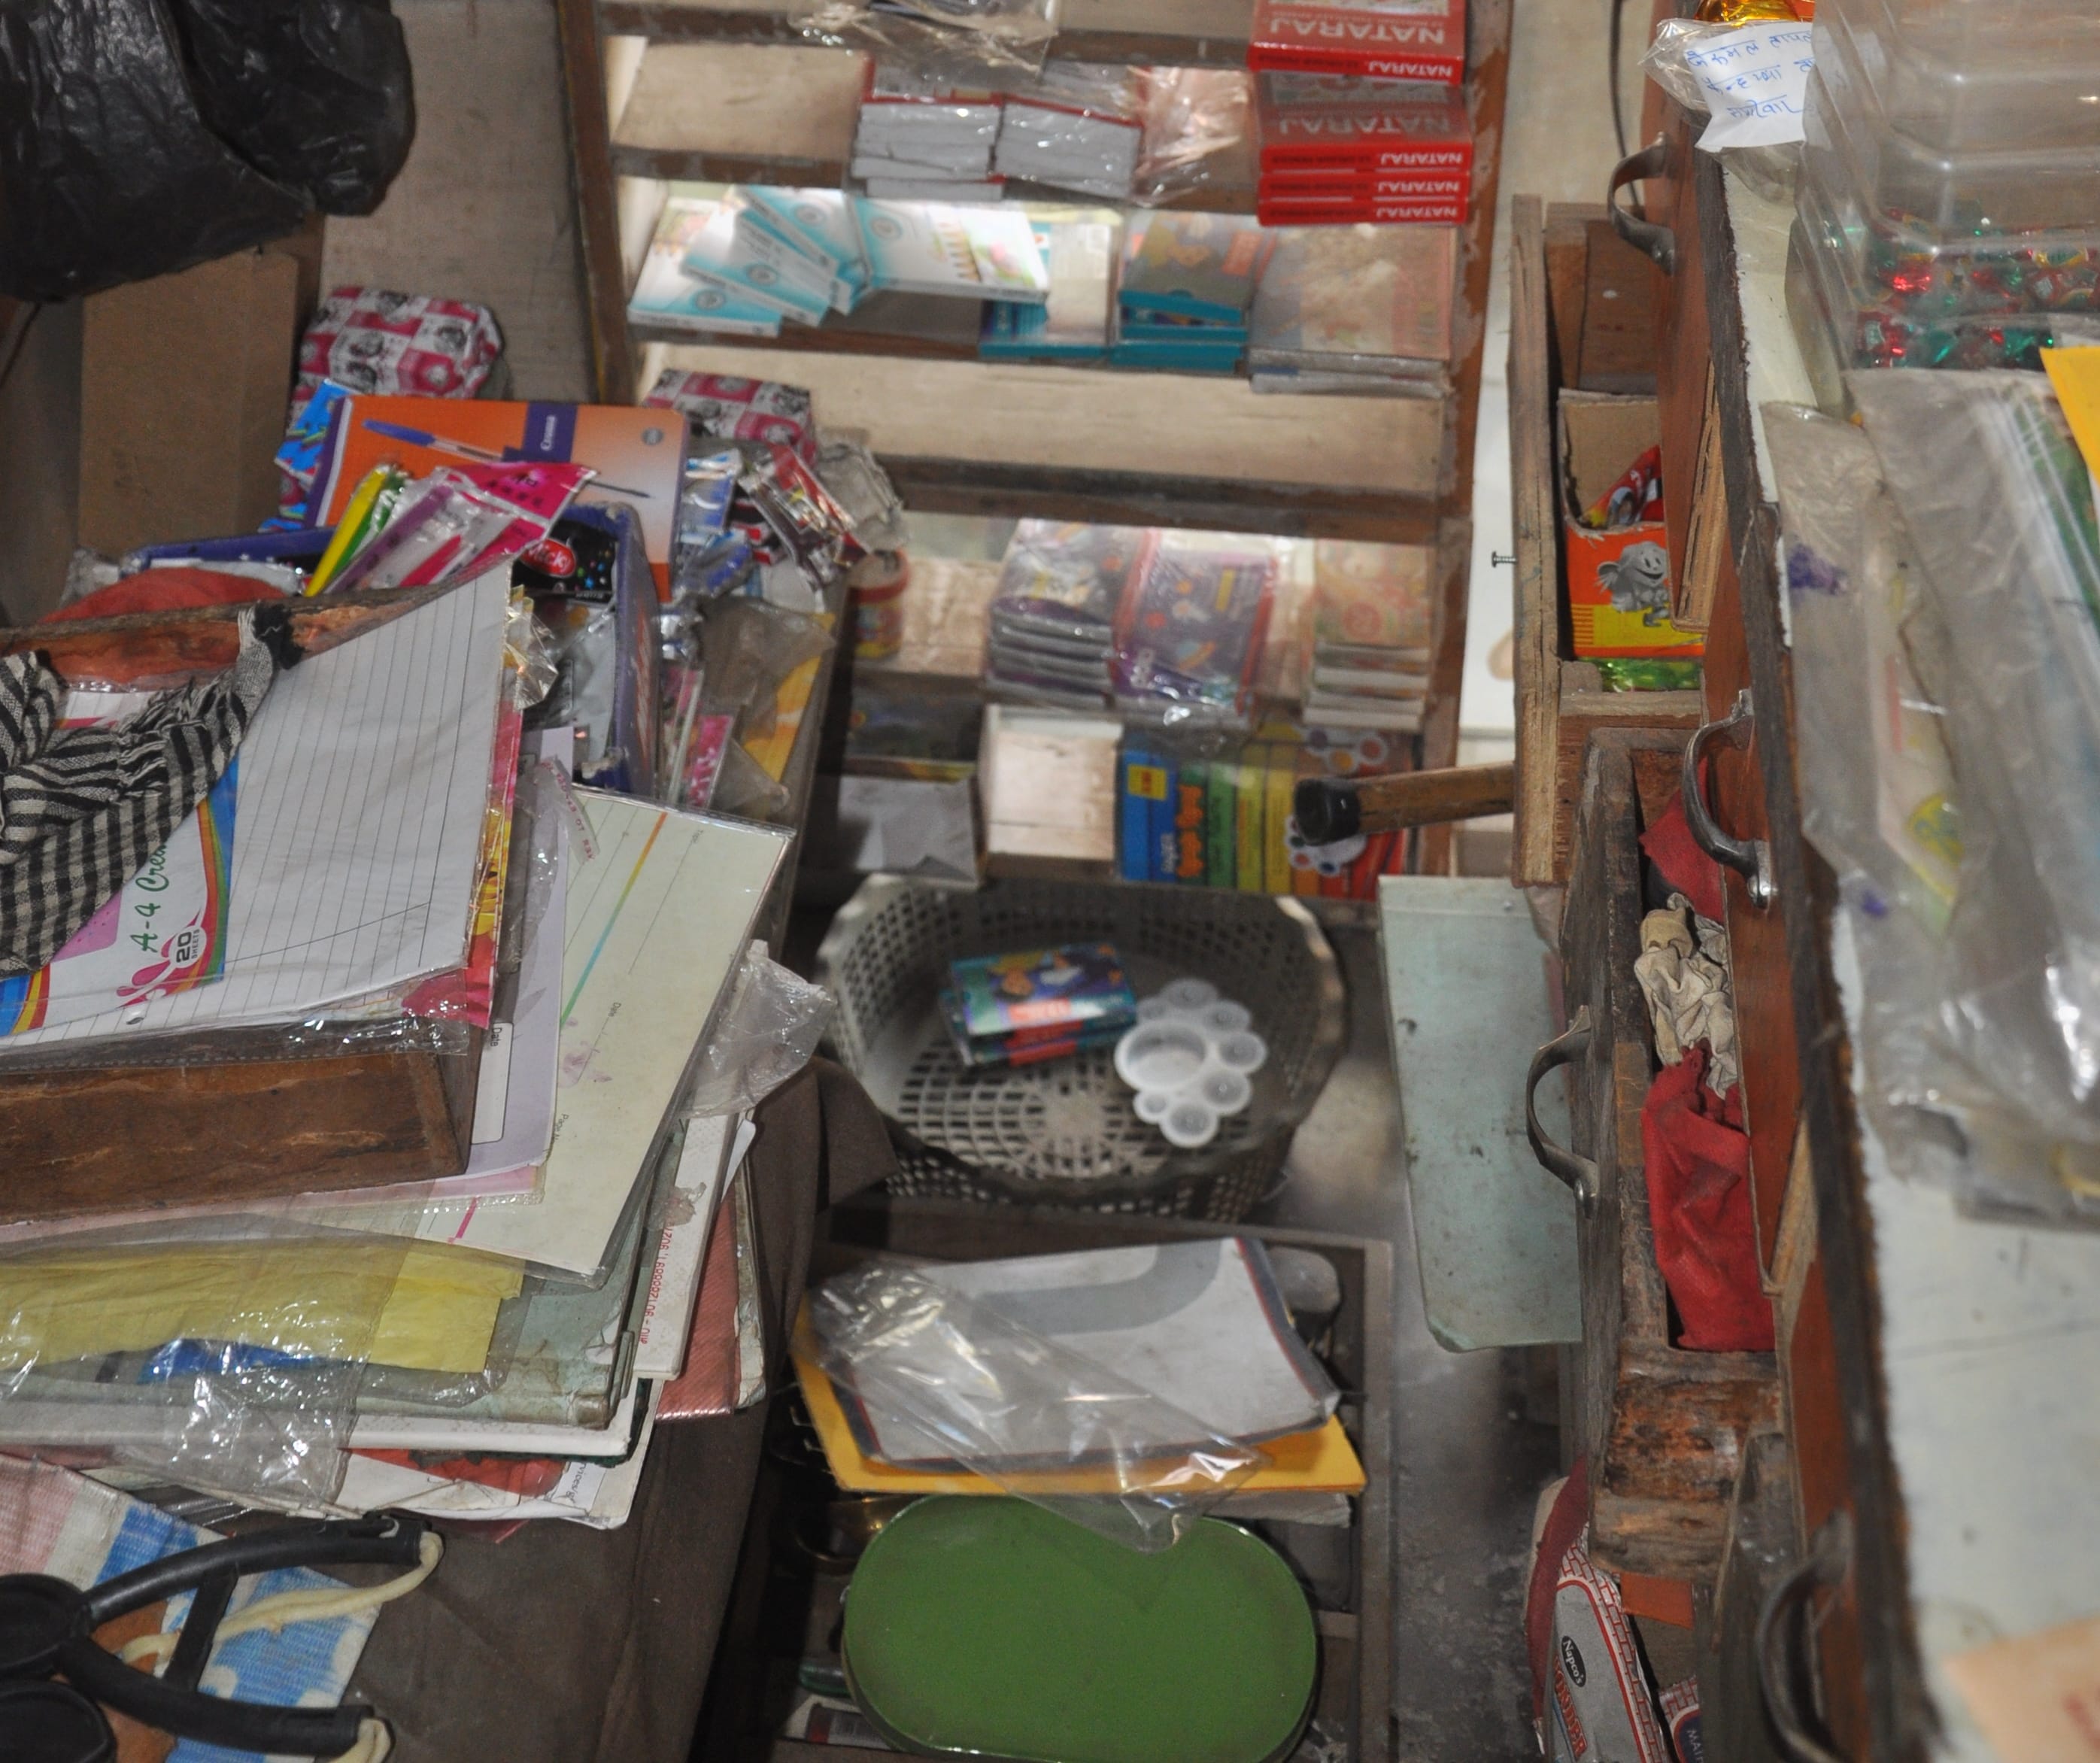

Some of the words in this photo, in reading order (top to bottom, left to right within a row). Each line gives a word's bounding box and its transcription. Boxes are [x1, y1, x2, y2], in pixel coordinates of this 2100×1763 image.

[1270, 17, 1444, 44] NATARAJ
[1368, 59, 1452, 77] NATARAJ
[1279, 111, 1450, 135] NATARAJ
[1380, 151, 1463, 164] NATARAJ
[1377, 181, 1460, 193] NATARAJ
[1376, 206, 1458, 218] NATARAJ
[129, 903, 161, 954] A-4
[176, 931, 193, 963] 20
[192, 928, 201, 960] SHEETS
[490, 1027, 502, 1047] Date
[1562, 1640, 1585, 1685] Napco's
